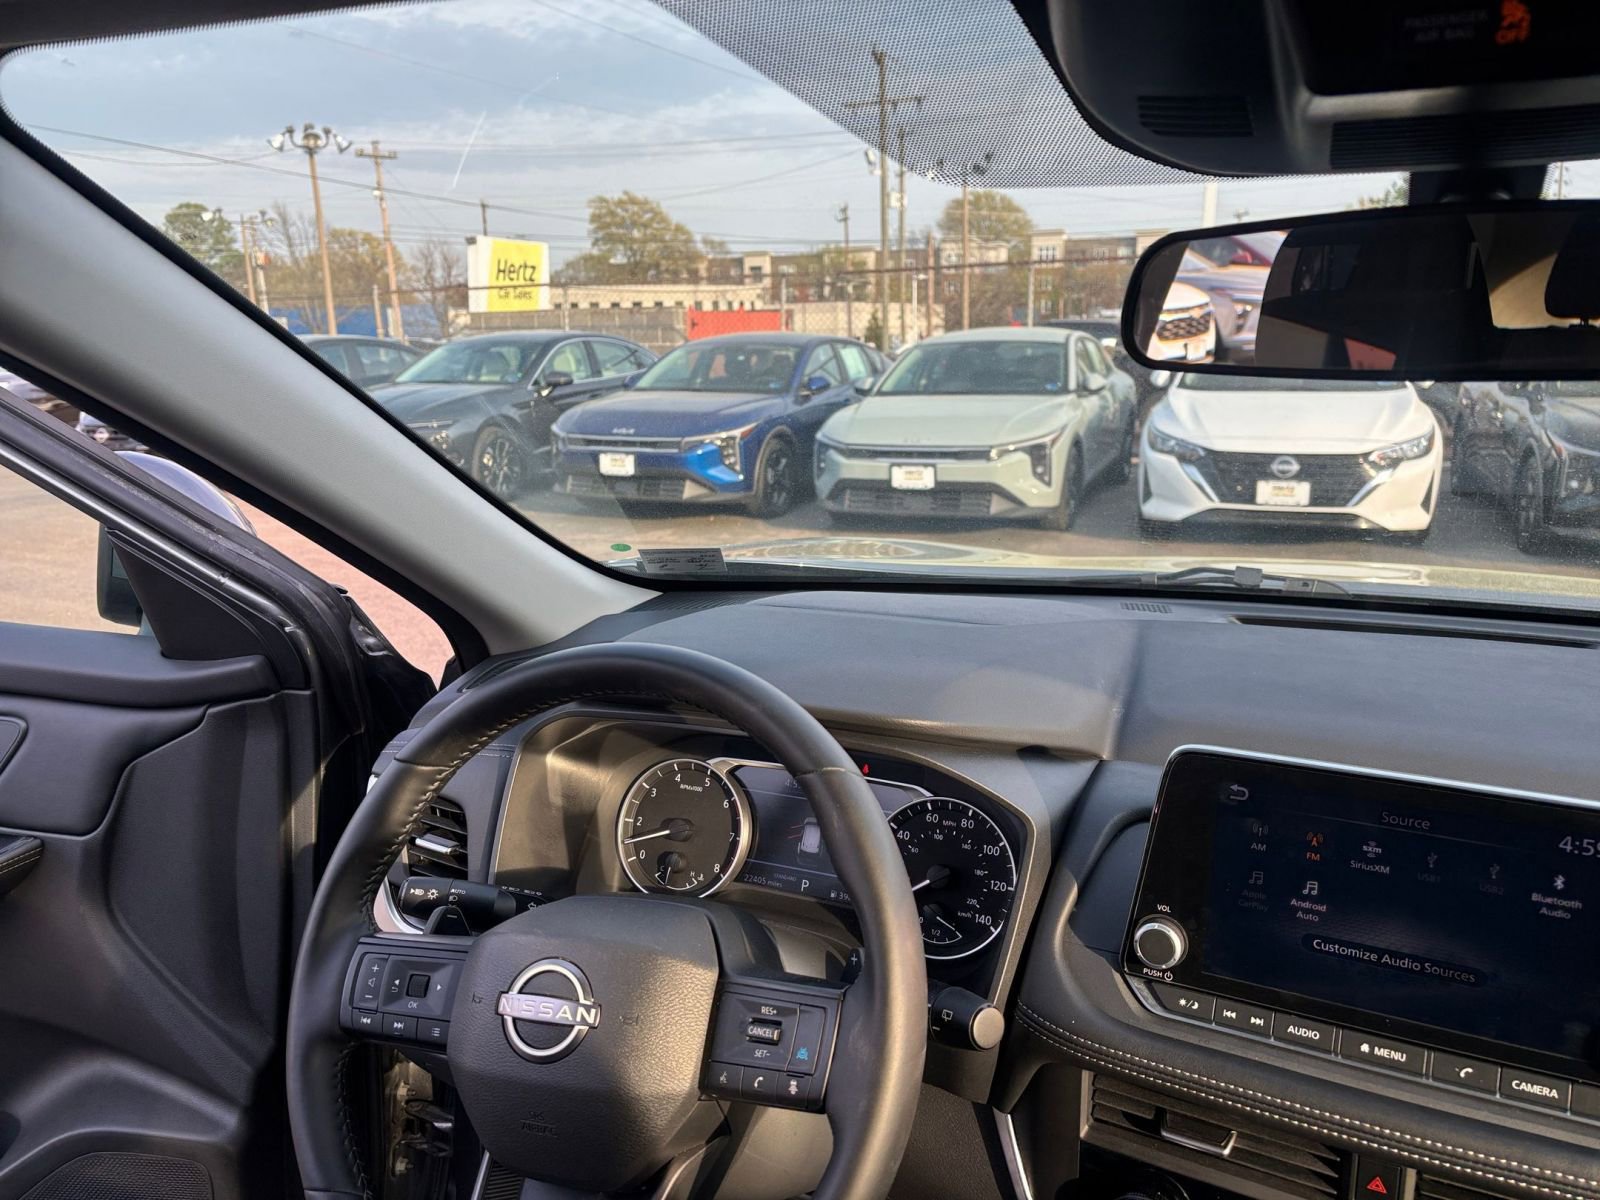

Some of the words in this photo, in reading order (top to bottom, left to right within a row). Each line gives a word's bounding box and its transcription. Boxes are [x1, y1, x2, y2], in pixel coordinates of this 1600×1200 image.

[496, 258, 537, 282] Hertz
[675, 774, 681, 783] 4
[704, 778, 711, 787] 5
[650, 788, 657, 798] 3
[723, 800, 730, 809] 6
[636, 817, 643, 827] 2
[926, 813, 939, 824] 60
[942, 820, 957, 828] MPH
[960, 818, 975, 830] 80
[1381, 811, 1431, 831] Source
[729, 832, 736, 842] 7
[896, 830, 911, 841] 40
[933, 832, 944, 841] 100
[982, 844, 1000, 856] 100
[1251, 842, 1267, 852] AM
[639, 850, 646, 860] 0
[1306, 852, 1321, 862] FM
[713, 863, 720, 873] 8
[1350, 859, 1391, 875] SiriusXM
[744, 873, 767, 885] 22405
[767, 879, 783, 888] miles
[800, 879, 810, 892] P
[990, 879, 1007, 892] 120
[450, 887, 467, 896] AUTO
[1290, 898, 1327, 913] Android
[1531, 892, 1584, 910] Bluetooth
[1156, 904, 1172, 913] VOL
[1538, 906, 1572, 920] Audio
[974, 913, 992, 926] 140
[1296, 911, 1319, 922] Auto
[930, 928, 941, 936] 1/2
[1312, 938, 1379, 963] Customize
[1381, 954, 1421, 972] Audio
[1424, 962, 1477, 984] Sources
[1143, 967, 1163, 979] PUSH
[407, 1001, 418, 1009] OK
[499, 998, 597, 1024] NISSAN
[761, 1006, 778, 1016] RES+
[748, 1026, 773, 1038] CANCEL
[1287, 1024, 1320, 1040] AUDIO
[1373, 1046, 1407, 1062] MENU
[1511, 1079, 1559, 1099] CAMERA
